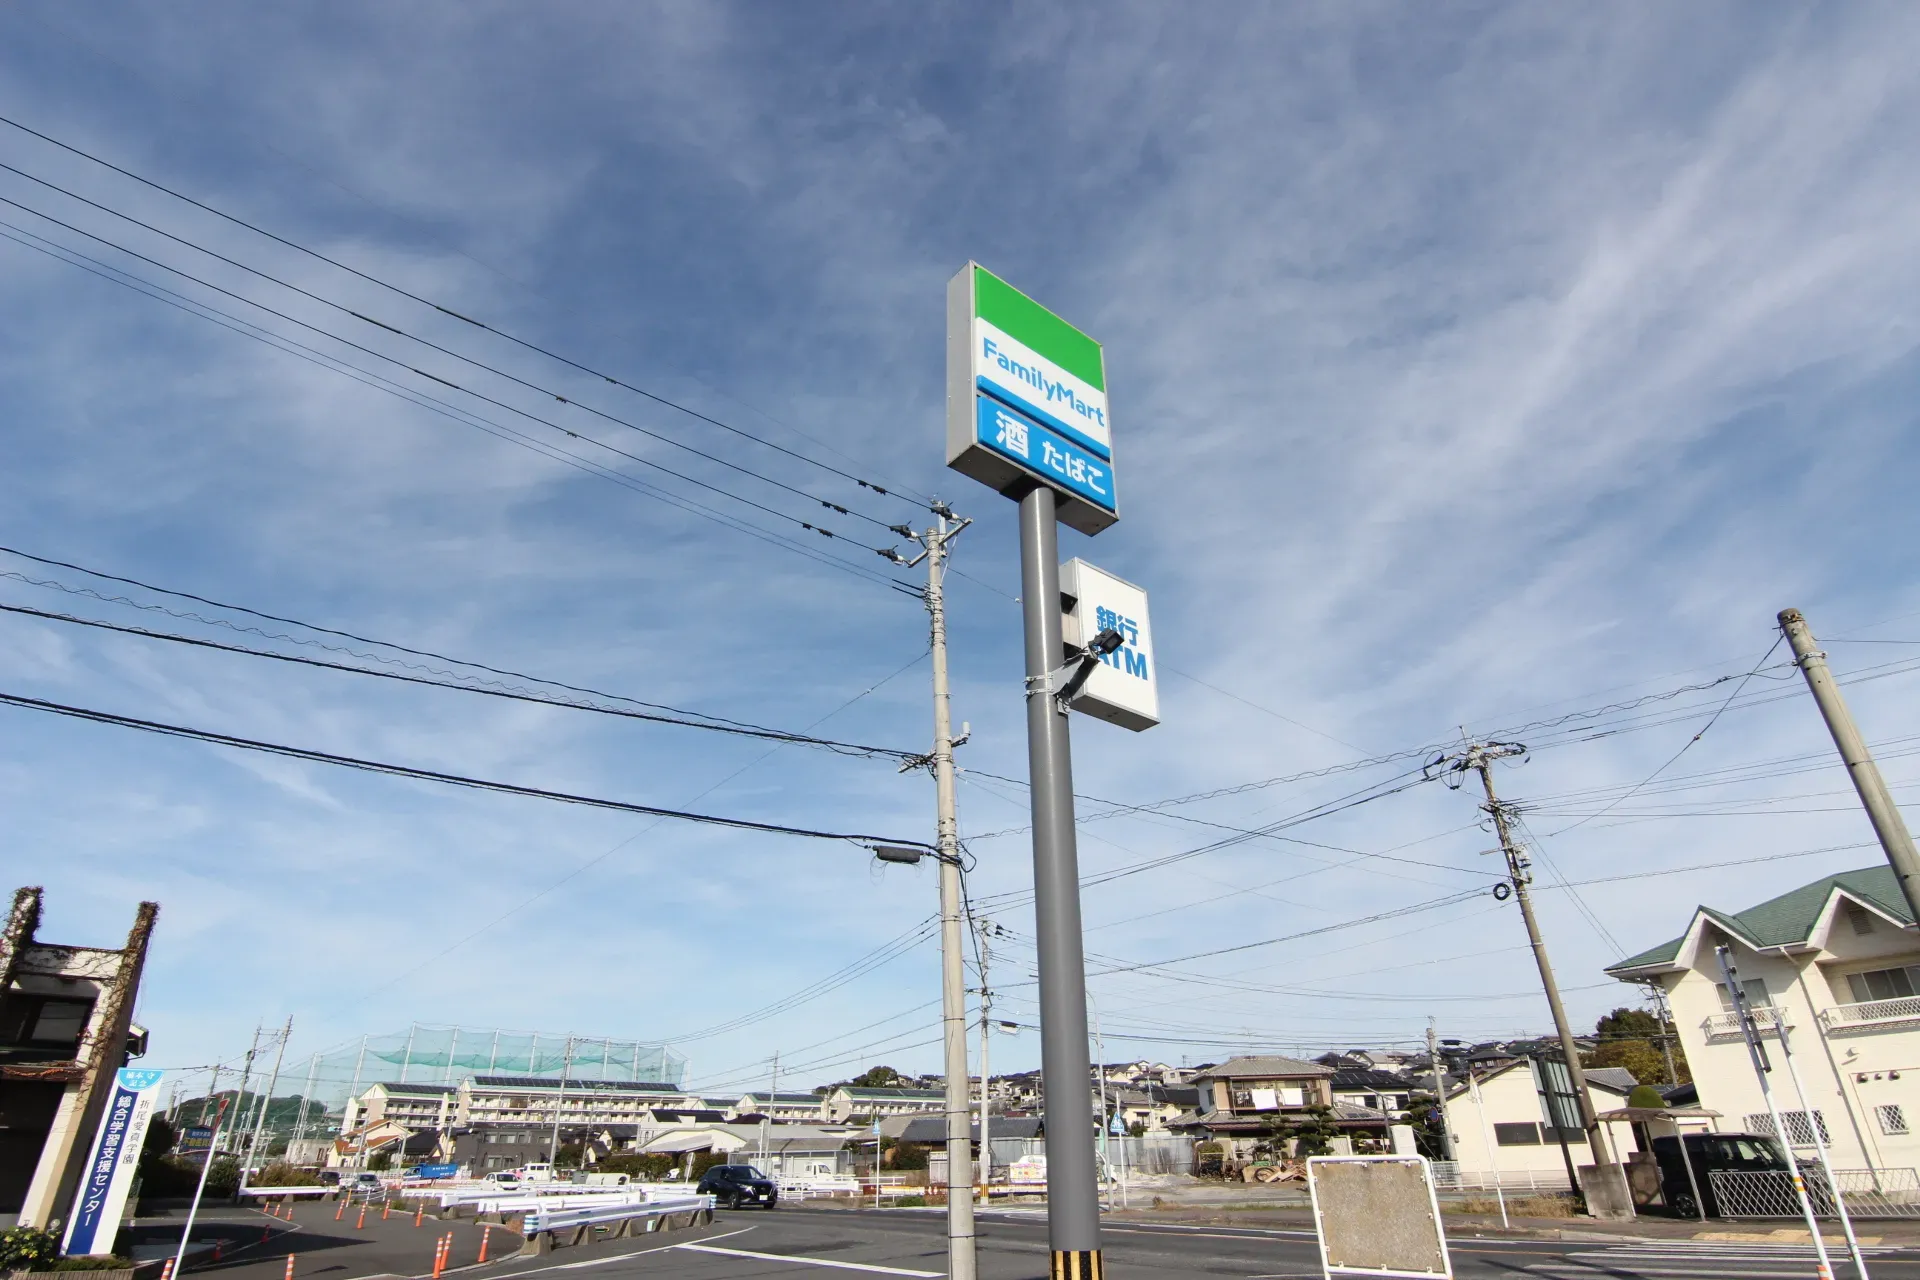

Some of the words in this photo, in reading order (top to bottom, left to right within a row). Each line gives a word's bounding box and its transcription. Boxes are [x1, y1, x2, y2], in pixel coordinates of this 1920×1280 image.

[983, 336, 1105, 427] FamilyMart
[996, 410, 1029, 459] 酒
[1042, 440, 1106, 495] たばこ
[1096, 605, 1139, 647] 銀行
[84, 1095, 132, 1227] 総合学習支援センター
[122, 1099, 150, 1165] 折尾愛真学園
